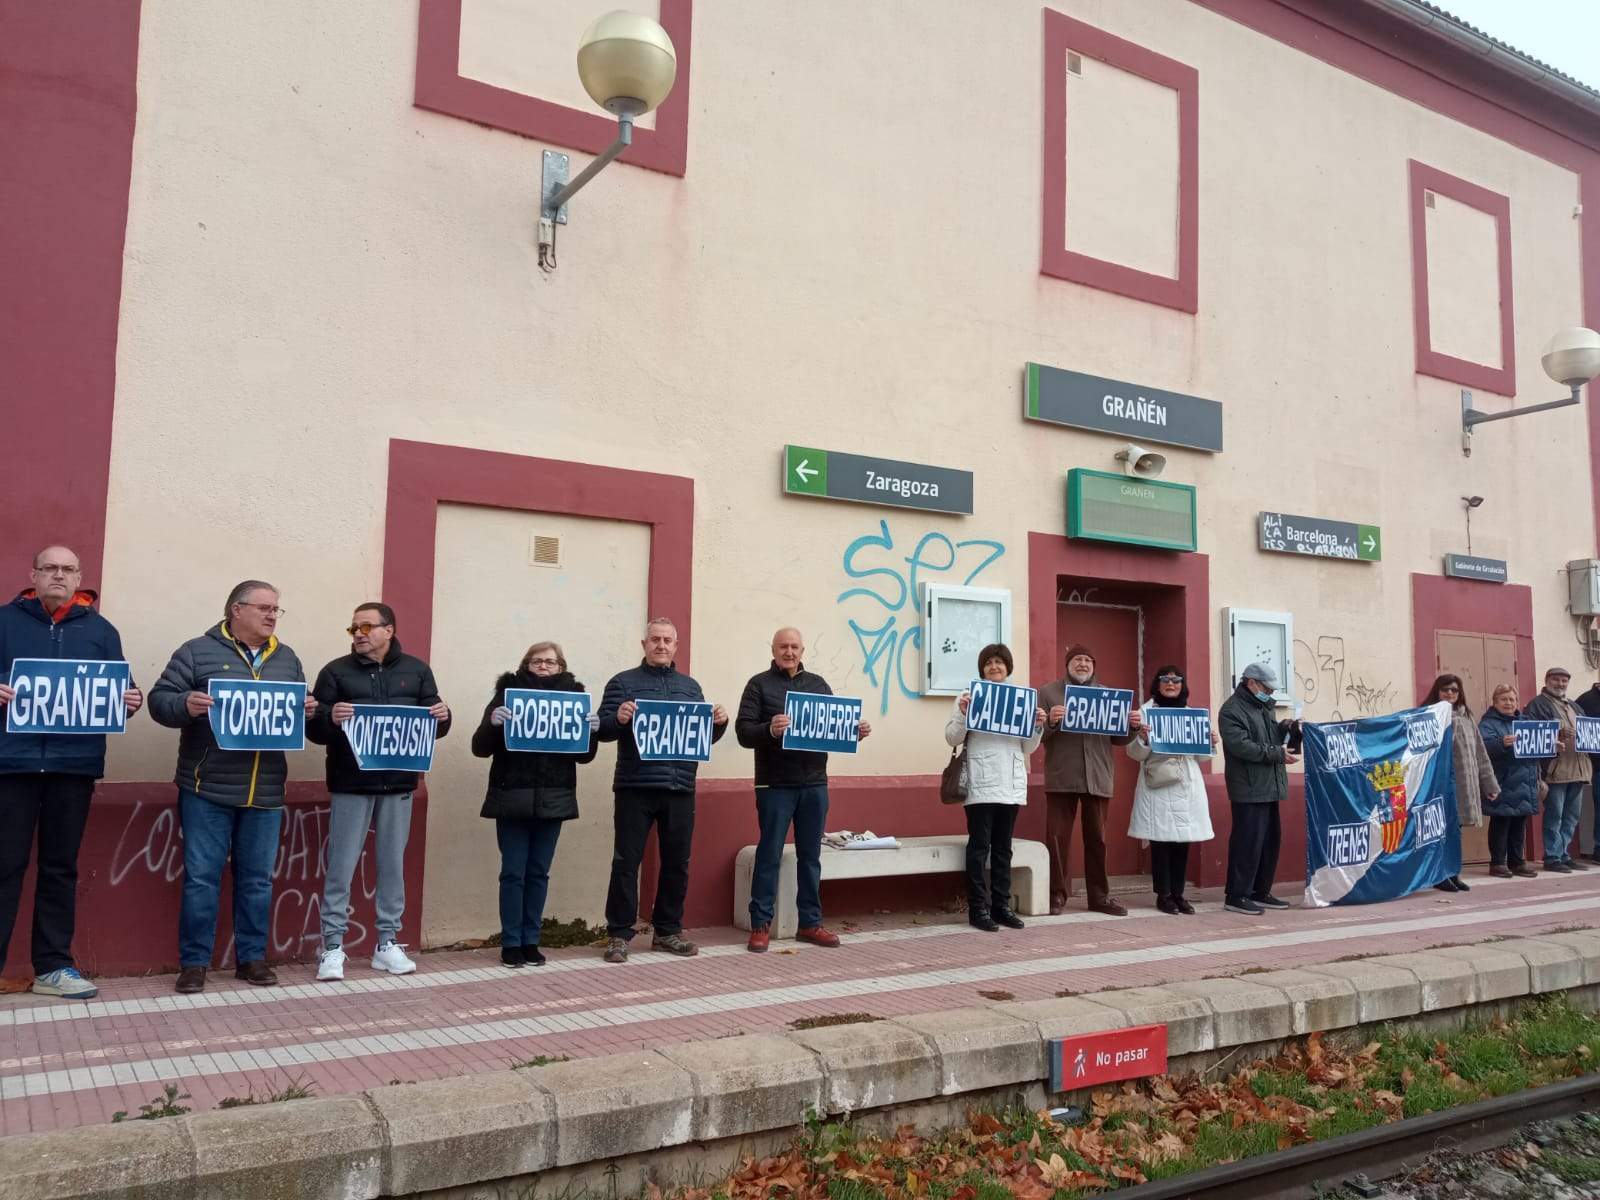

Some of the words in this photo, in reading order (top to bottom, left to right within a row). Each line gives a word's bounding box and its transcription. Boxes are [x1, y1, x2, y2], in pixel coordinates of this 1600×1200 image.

[1102, 395, 1168, 427] GRAÑÉN
[865, 470, 939, 498] Zaragoza
[1287, 527, 1338, 545] Barcelona
[12, 664, 127, 727] GRAÑÉN
[218, 689, 297, 736] TORRES
[968, 682, 1036, 735] CALLEN
[1066, 690, 1131, 732] GRAÑÉN
[510, 697, 584, 741] ROBRES
[635, 703, 712, 756] GRAÑÉN
[785, 699, 860, 742] ALCUBIERRE
[1149, 715, 1209, 745] ALMUNIENTE
[1515, 723, 1558, 754] GRAÑÉN
[1329, 825, 1368, 865] TRENES
[1096, 1051, 1111, 1067] No
[1115, 1047, 1149, 1066] pasar
